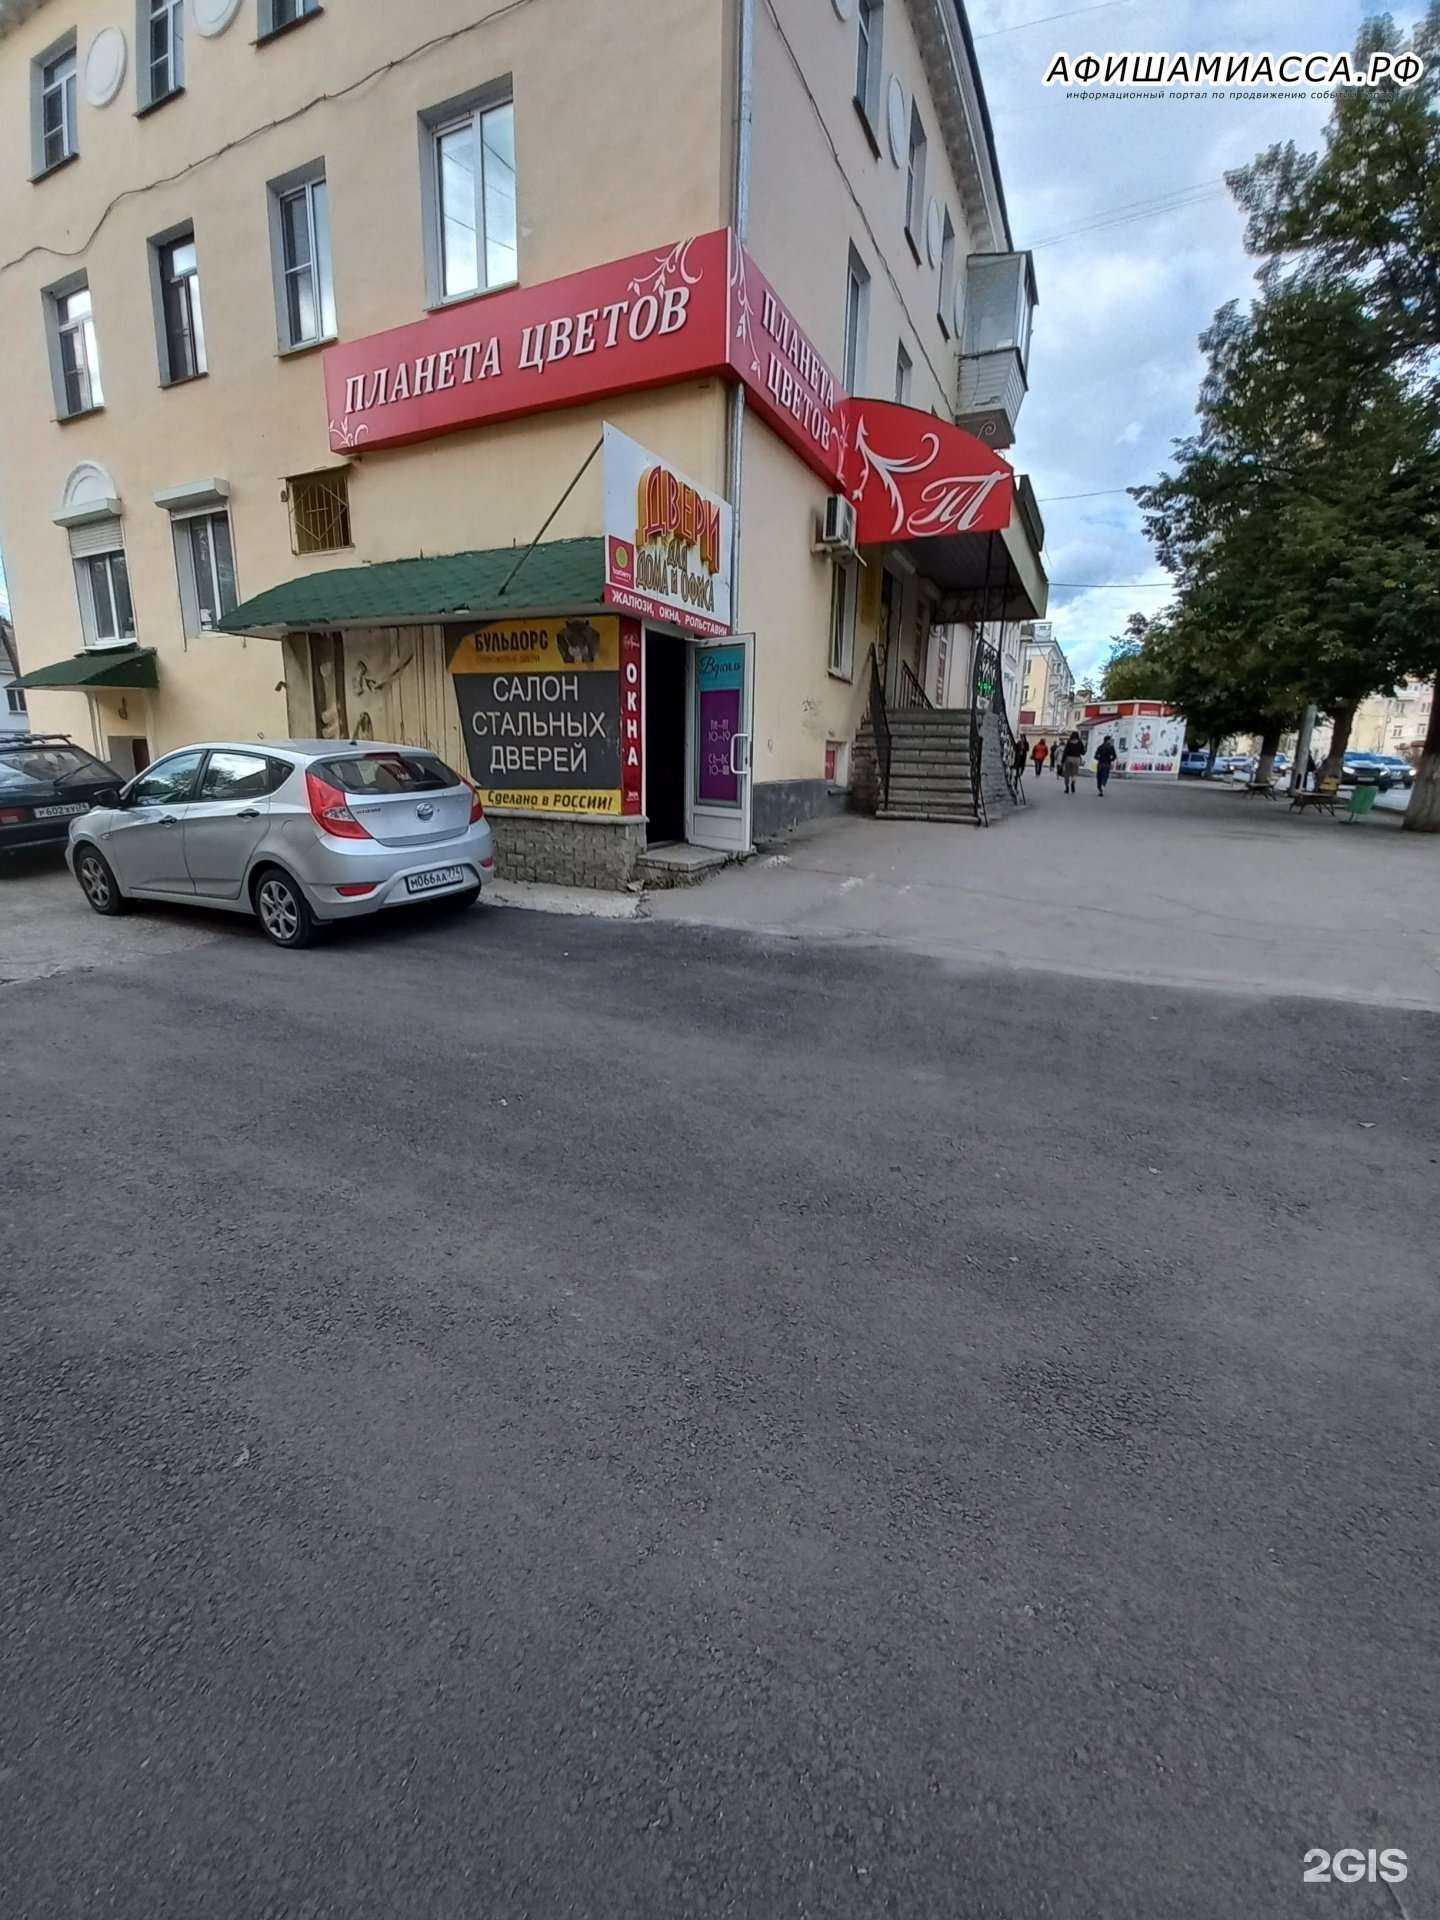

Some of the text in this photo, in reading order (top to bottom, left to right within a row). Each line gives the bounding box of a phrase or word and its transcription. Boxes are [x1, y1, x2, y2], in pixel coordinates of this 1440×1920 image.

[345, 286, 692, 414] ПЛАНЕТА ЦВЕТОВ
[762, 289, 836, 413] ПЛАНЕТА
[766, 352, 831, 451] ЦВЕТОВ
[638, 465, 720, 574] ДВЕРИ
[667, 538, 688, 570] ДЛЯ
[636, 550, 669, 597] ДОМА
[681, 570, 714, 613] ОФИСА
[612, 589, 655, 617] ЖАЛЮЗИ,
[659, 605, 681, 625] ОКНА,
[475, 630, 548, 652] БУЛЬДОРС
[493, 675, 578, 702] САЛОН
[472, 712, 606, 738] СТАЛЬНЫХ
[626, 662, 639, 766] ОКНА
[490, 742, 587, 774] ДВЕРЕЙ
[488, 790, 538, 804] Сделано
[542, 796, 549, 806] в
[553, 794, 613, 810] РОССИИ!
